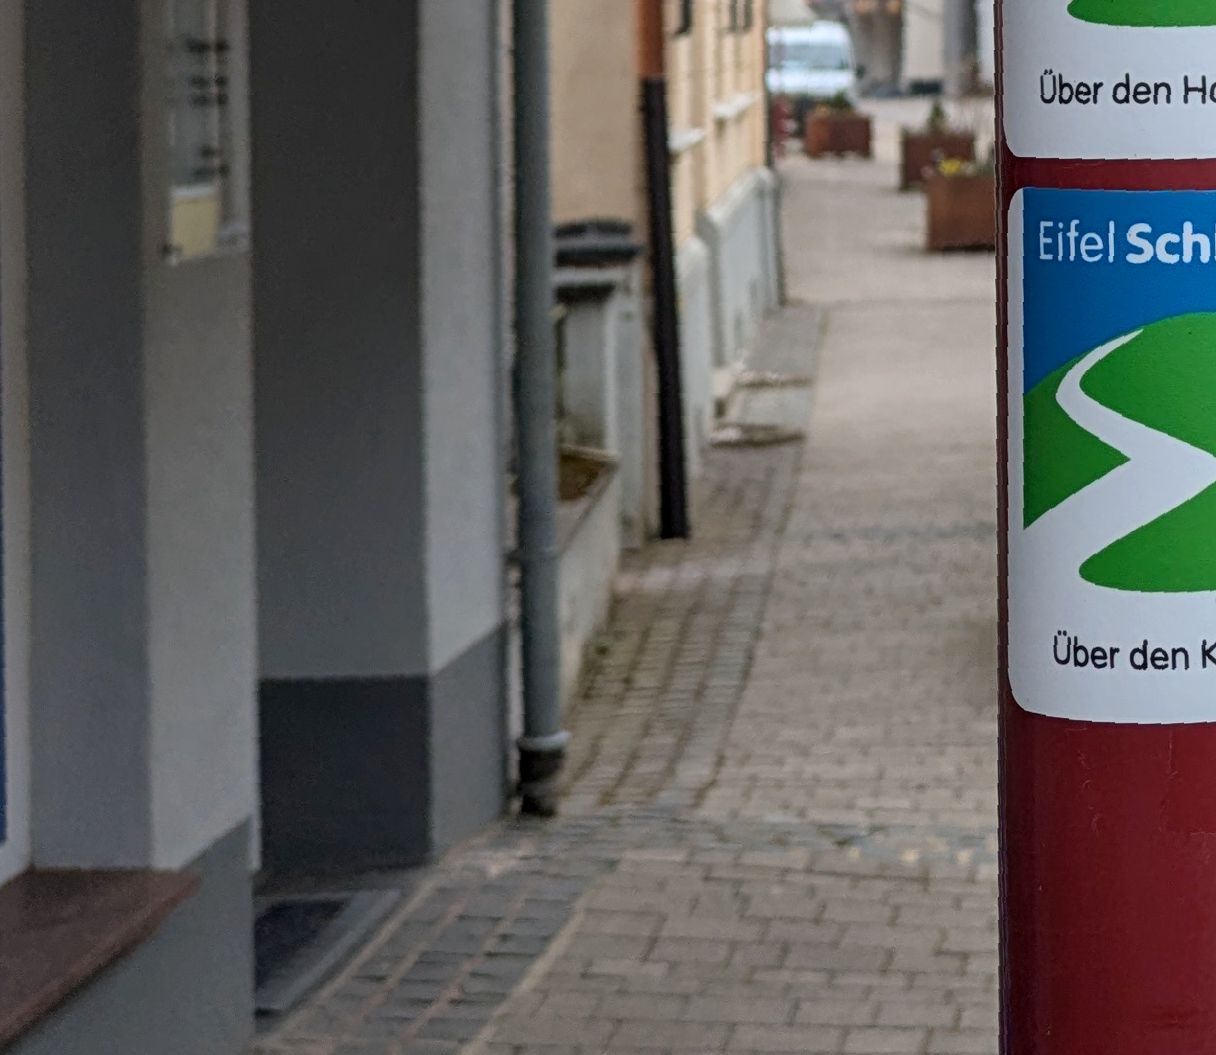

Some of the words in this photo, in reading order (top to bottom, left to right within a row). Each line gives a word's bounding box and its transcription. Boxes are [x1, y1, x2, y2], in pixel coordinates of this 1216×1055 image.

[1039, 68, 1104, 106] Über
[1111, 72, 1172, 105] den
[1039, 219, 1115, 263] Eifel
[1052, 629, 1121, 670] Über
[1129, 638, 1190, 671] den
